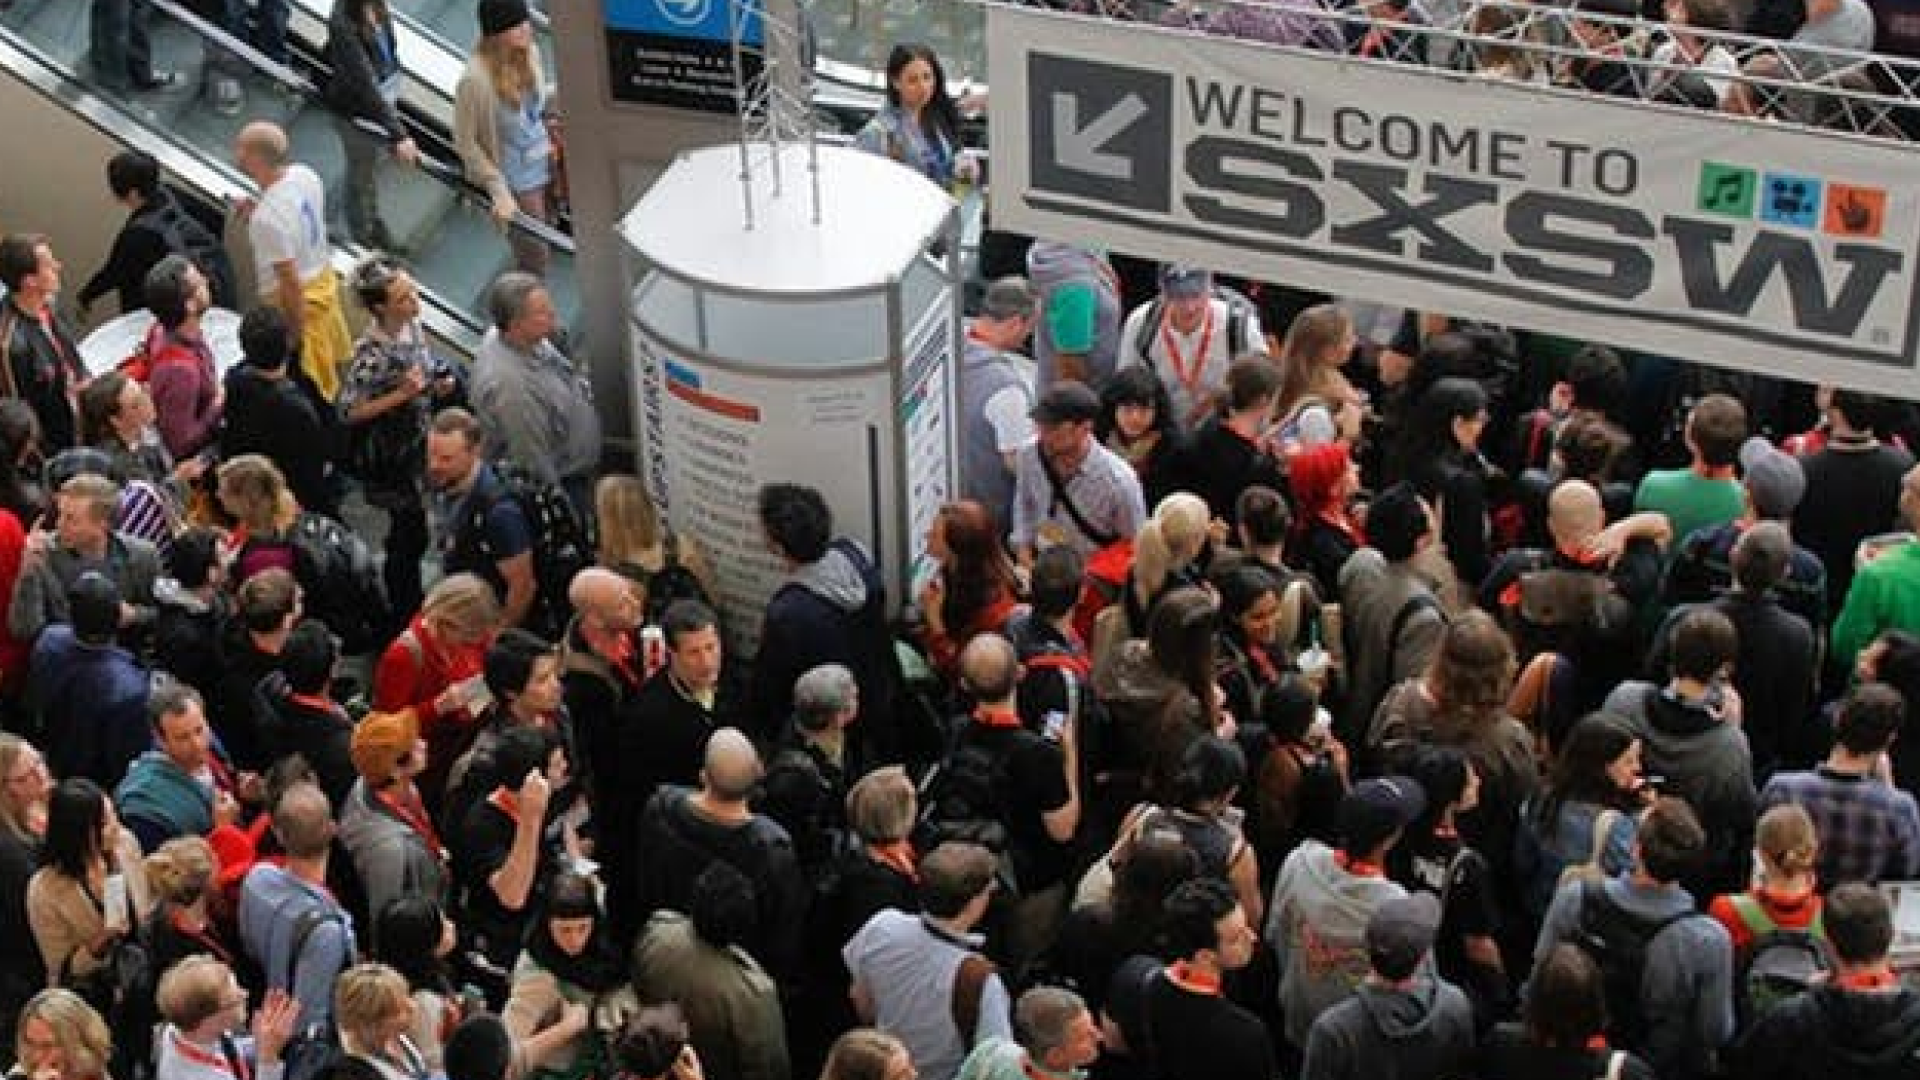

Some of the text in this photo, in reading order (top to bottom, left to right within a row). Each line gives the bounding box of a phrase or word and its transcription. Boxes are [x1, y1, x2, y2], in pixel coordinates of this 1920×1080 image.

[1187, 77, 1638, 195] WELCOME TO
[1182, 134, 1903, 339] SXSW
